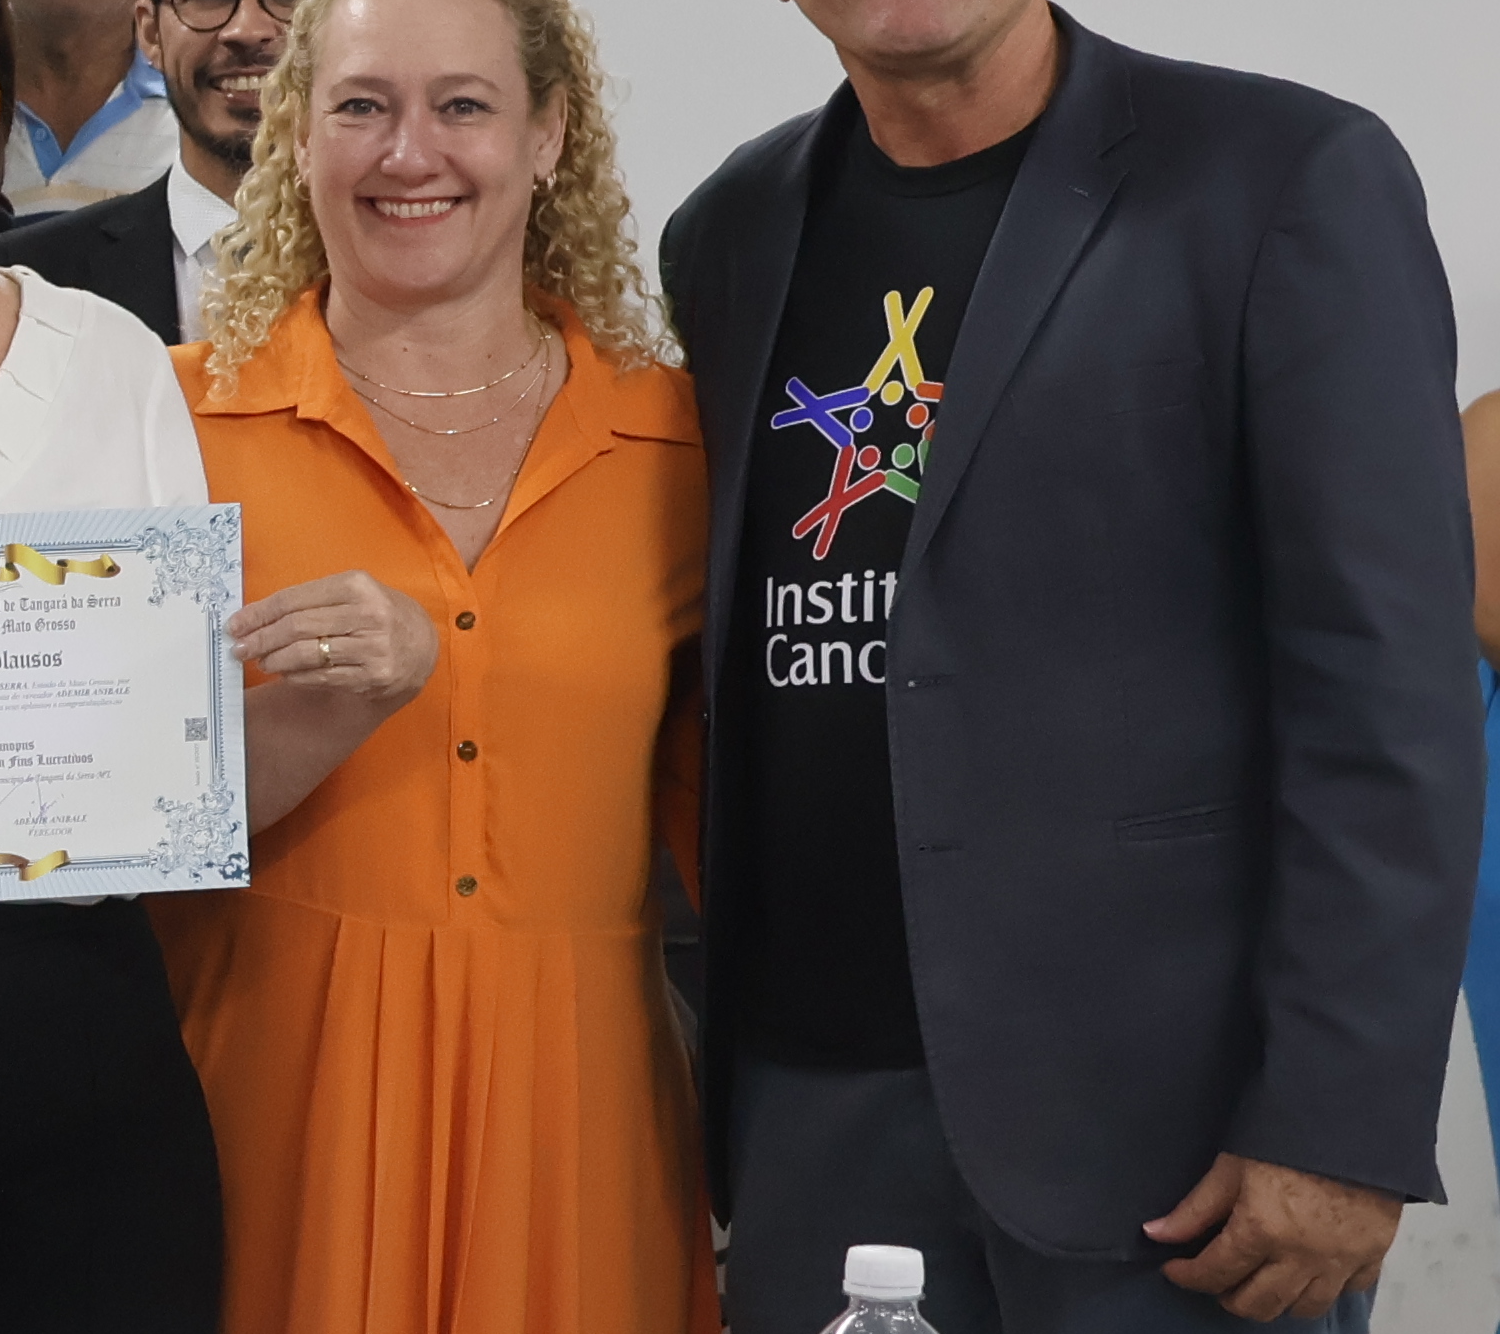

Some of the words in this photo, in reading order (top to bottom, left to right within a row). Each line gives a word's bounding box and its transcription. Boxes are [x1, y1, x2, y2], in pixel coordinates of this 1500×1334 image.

[3, 599, 15, 612] de
[19, 594, 67, 613] Tangará
[71, 597, 84, 609] da
[87, 594, 121, 609] Serra
[766, 569, 898, 628] Instit
[1, 619, 31, 634] Mato
[34, 618, 76, 632] Grosso
[8, 755, 34, 769] Fins
[37, 752, 94, 767] Lucrativos
